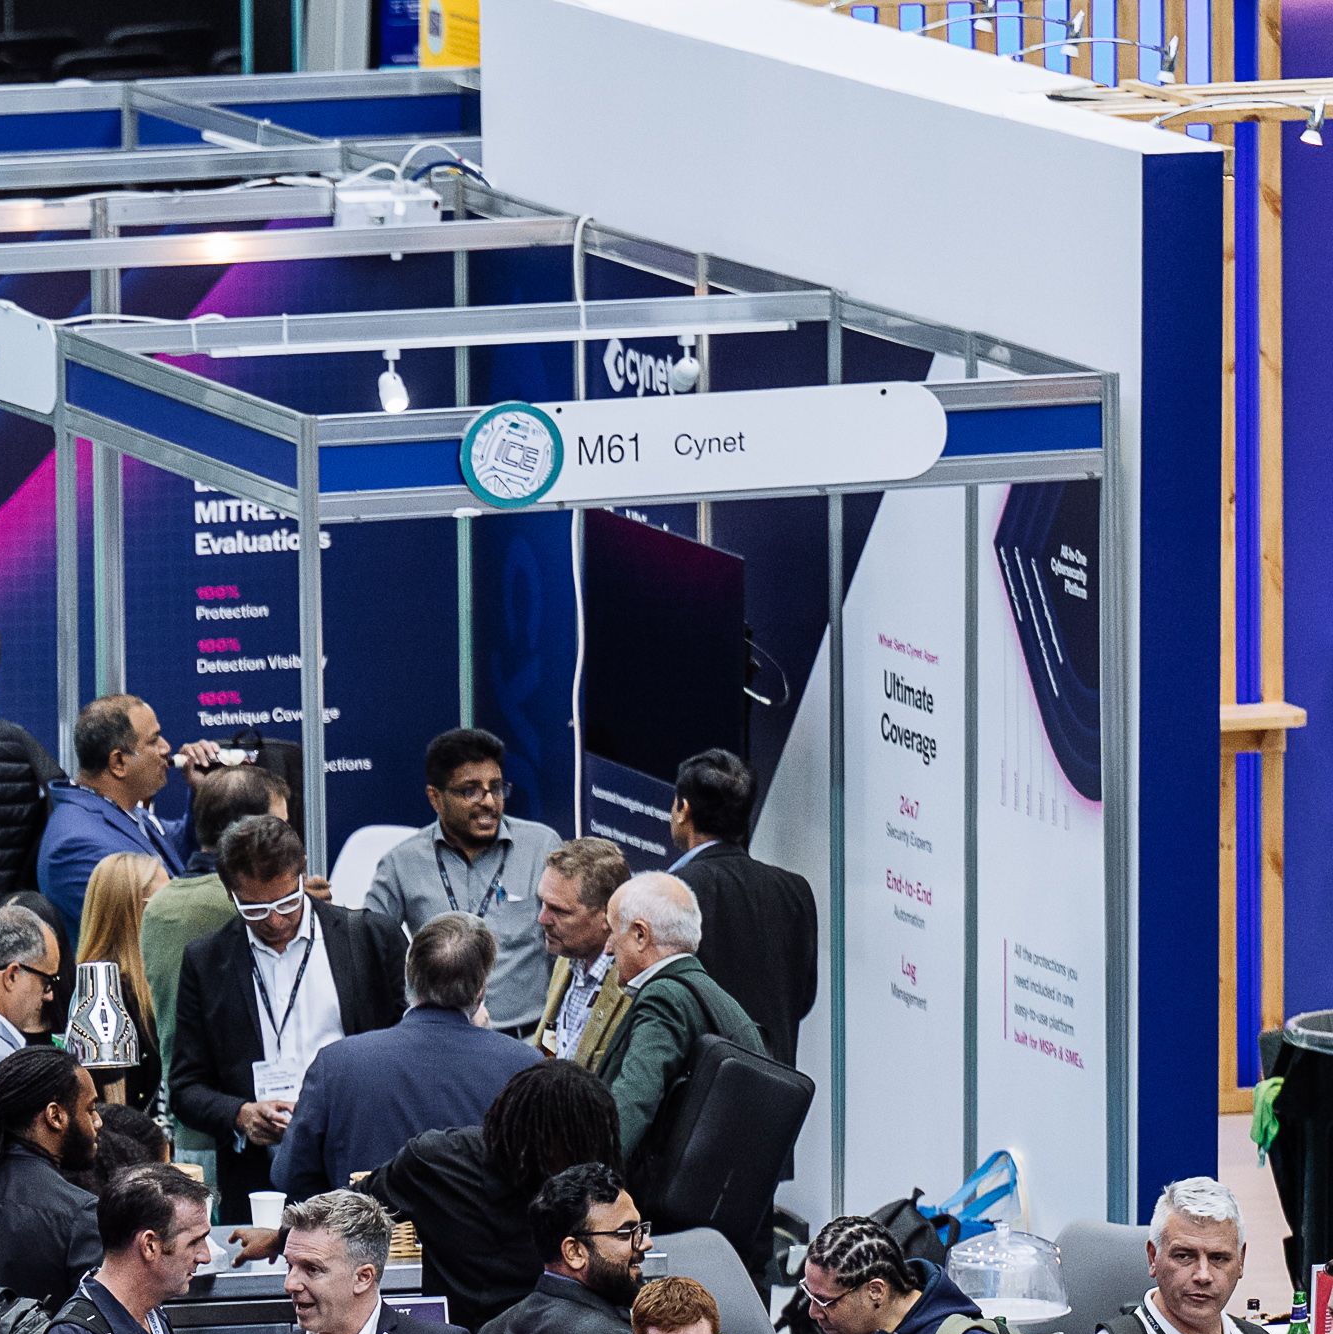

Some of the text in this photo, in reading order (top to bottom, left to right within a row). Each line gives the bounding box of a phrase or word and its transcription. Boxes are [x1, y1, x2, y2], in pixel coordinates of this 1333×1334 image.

[577, 431, 746, 466] M61 Cynet
[195, 527, 332, 556] Evaluatios
[195, 604, 270, 621] Protection
[196, 658, 267, 675] Detection
[884, 669, 934, 714] Ultimate
[197, 709, 271, 727] Technique
[880, 712, 937, 766] Coverage
[885, 867, 933, 906] End-to-End
